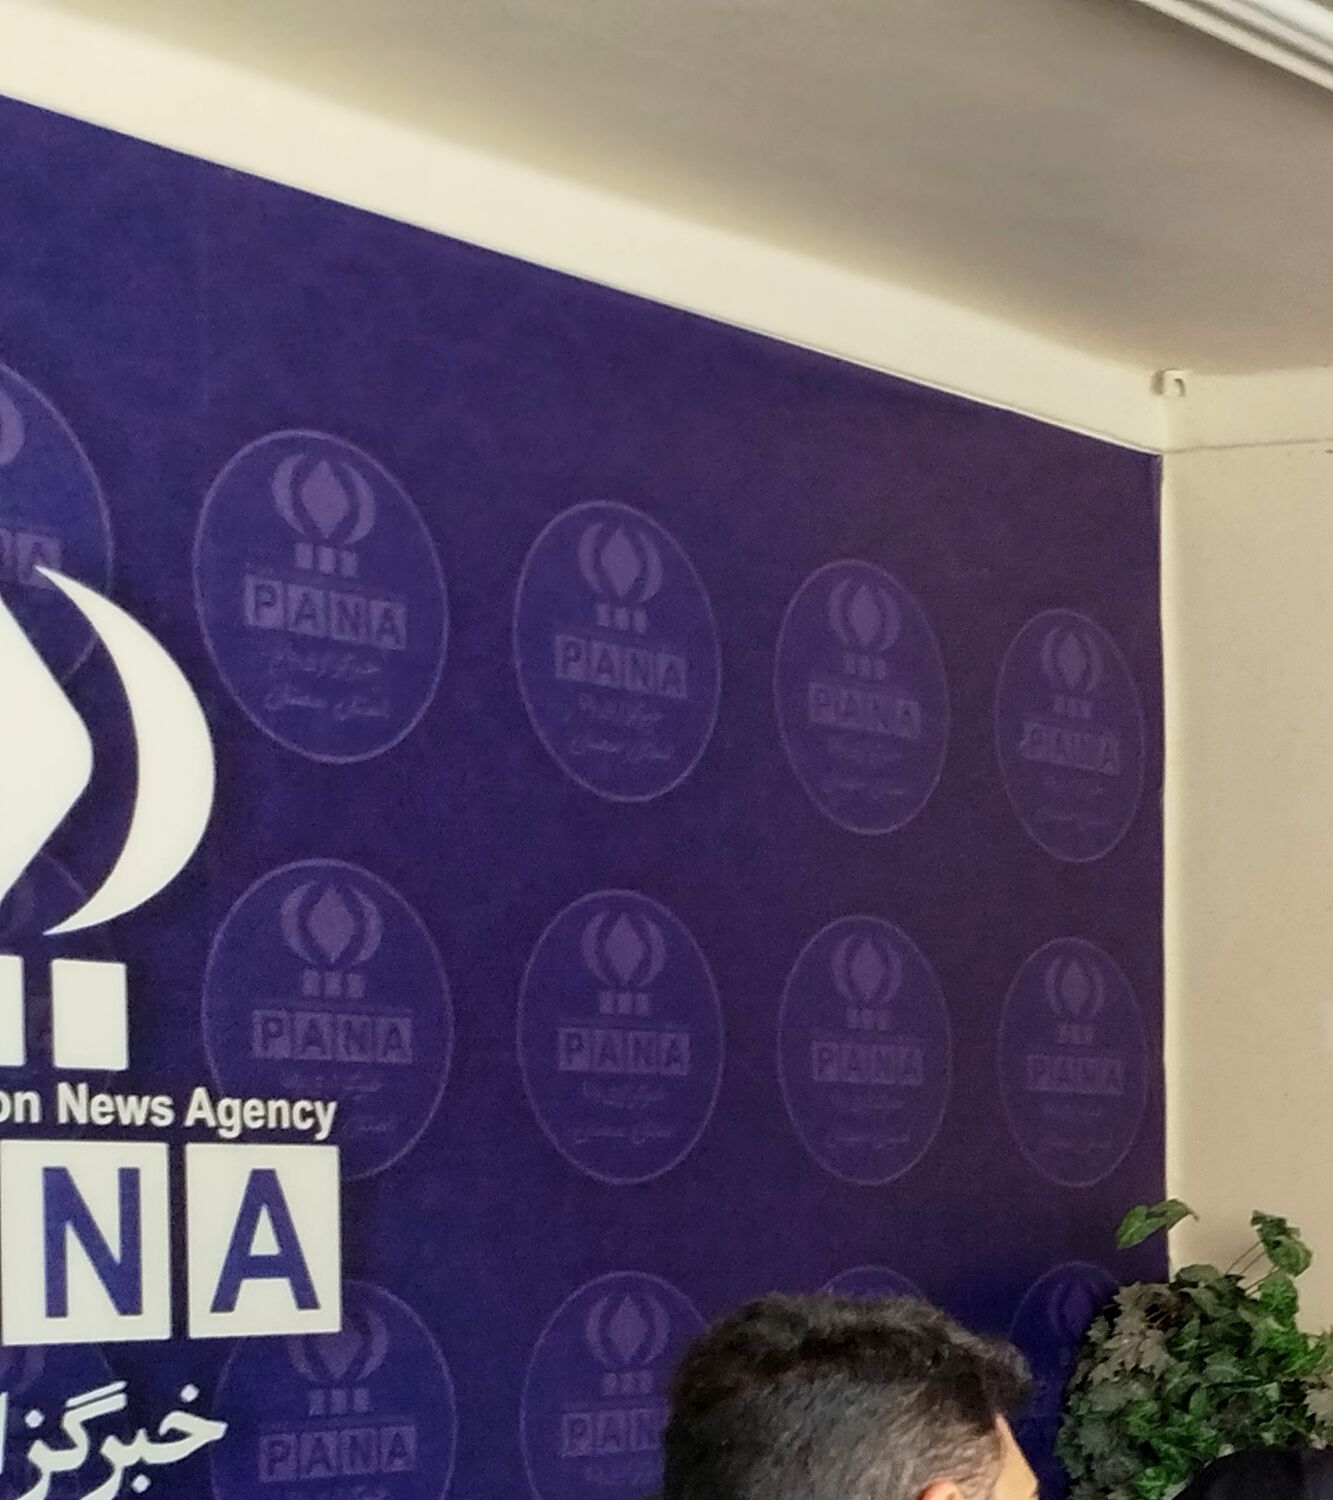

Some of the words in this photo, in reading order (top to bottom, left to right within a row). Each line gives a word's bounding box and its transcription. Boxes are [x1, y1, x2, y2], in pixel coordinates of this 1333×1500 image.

[249, 577, 403, 646] PANA
[558, 638, 686, 696] PANA
[256, 1013, 411, 1061] PANA
[560, 1030, 688, 1073] PANA
[57, 1082, 175, 1127] News
[184, 1086, 337, 1138] Agency
[34, 1159, 327, 1324] NA
[262, 1429, 414, 1480] PANA
[563, 1413, 662, 1454] PAN
